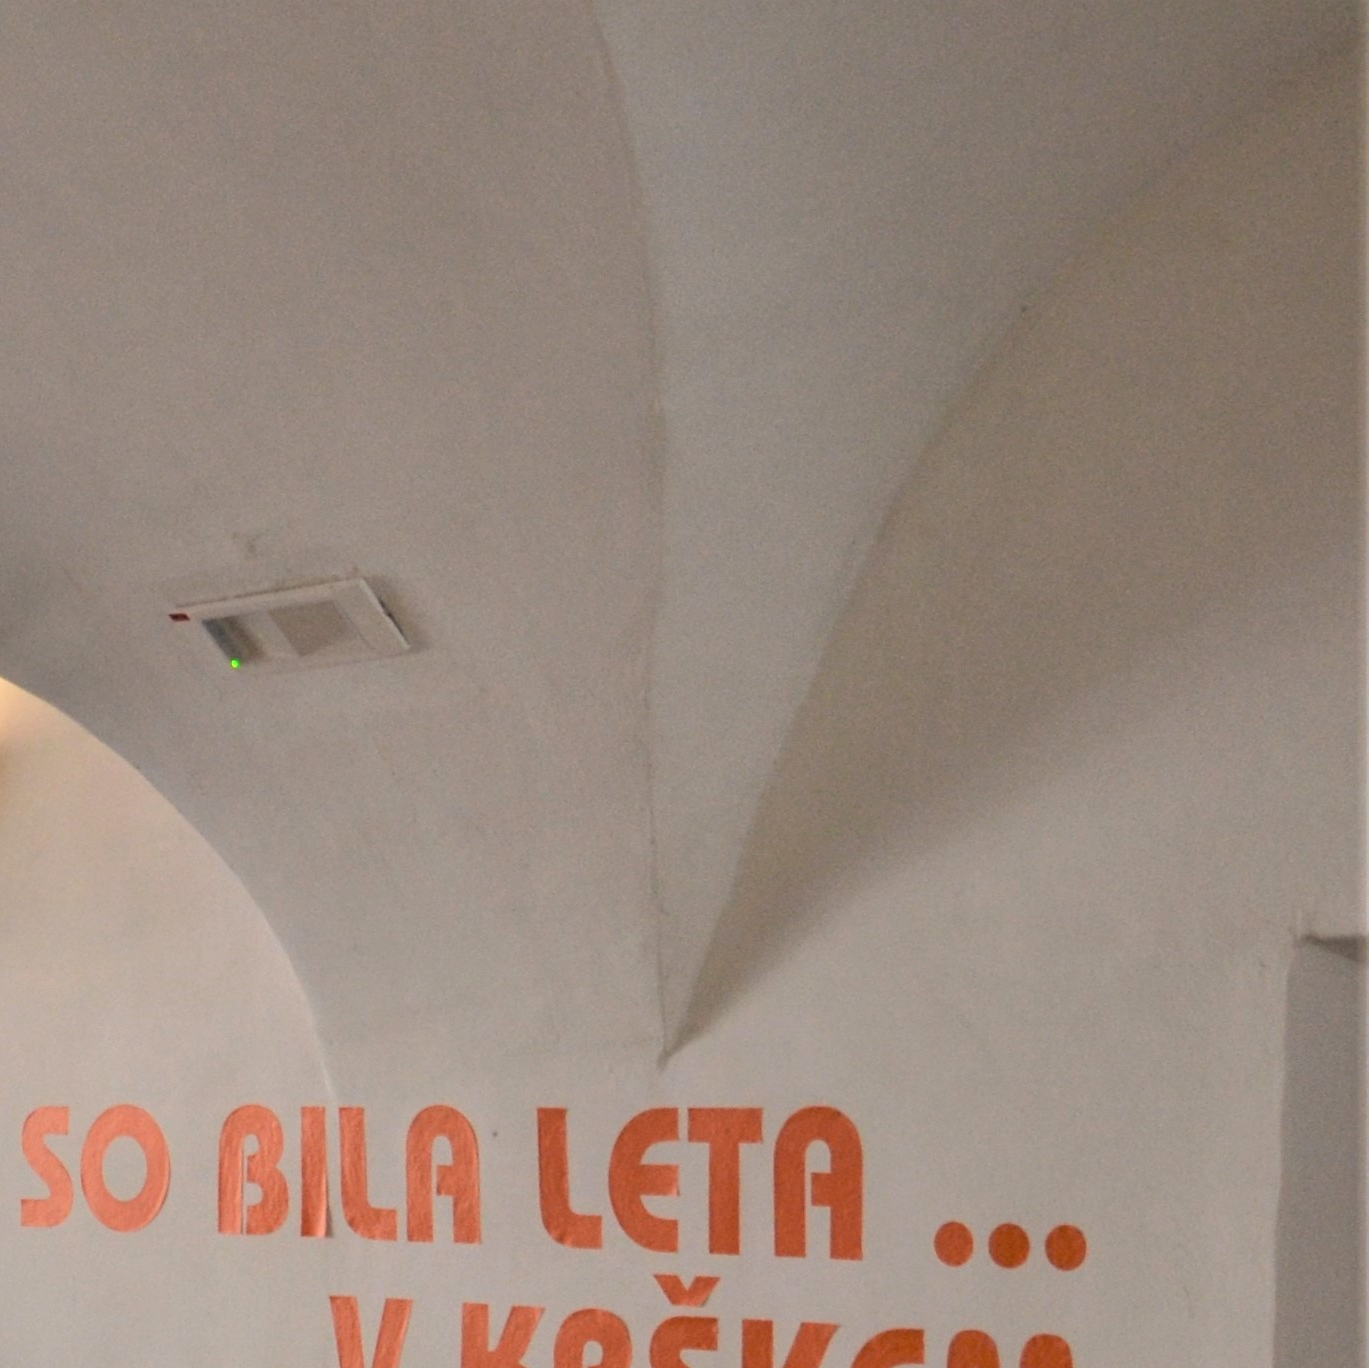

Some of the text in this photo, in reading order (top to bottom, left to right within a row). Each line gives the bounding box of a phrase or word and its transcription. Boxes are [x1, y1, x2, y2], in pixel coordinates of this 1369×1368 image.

[21, 1104, 172, 1233] SO
[217, 1104, 483, 1245] BILA
[536, 1105, 865, 1262] LETA
